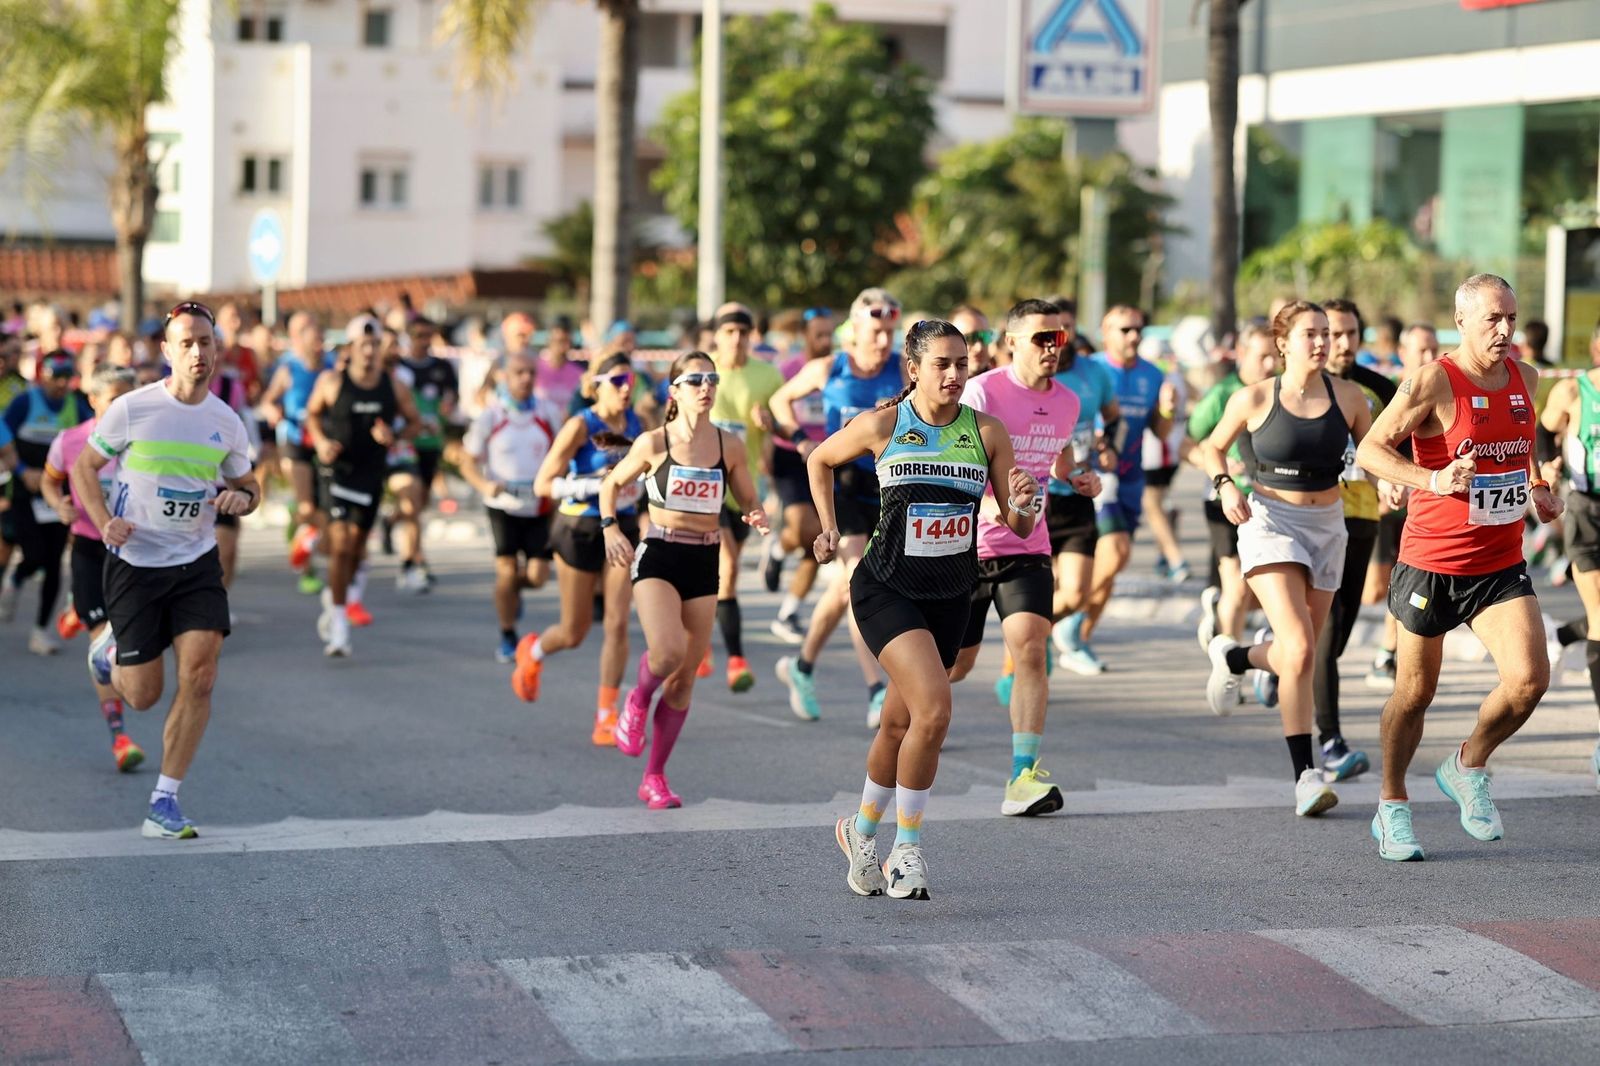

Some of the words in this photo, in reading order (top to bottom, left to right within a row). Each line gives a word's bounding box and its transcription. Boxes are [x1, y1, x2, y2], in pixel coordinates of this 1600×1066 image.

[1029, 423, 1056, 434] XXXVI
[1009, 434, 1032, 450] EDIA
[1455, 436, 1532, 462] Crossgates
[889, 463, 985, 483] TORREMOLINOS
[671, 480, 718, 498] 2021
[1474, 485, 1527, 509] 1745
[163, 500, 200, 518] 378
[912, 516, 970, 539] 1440
